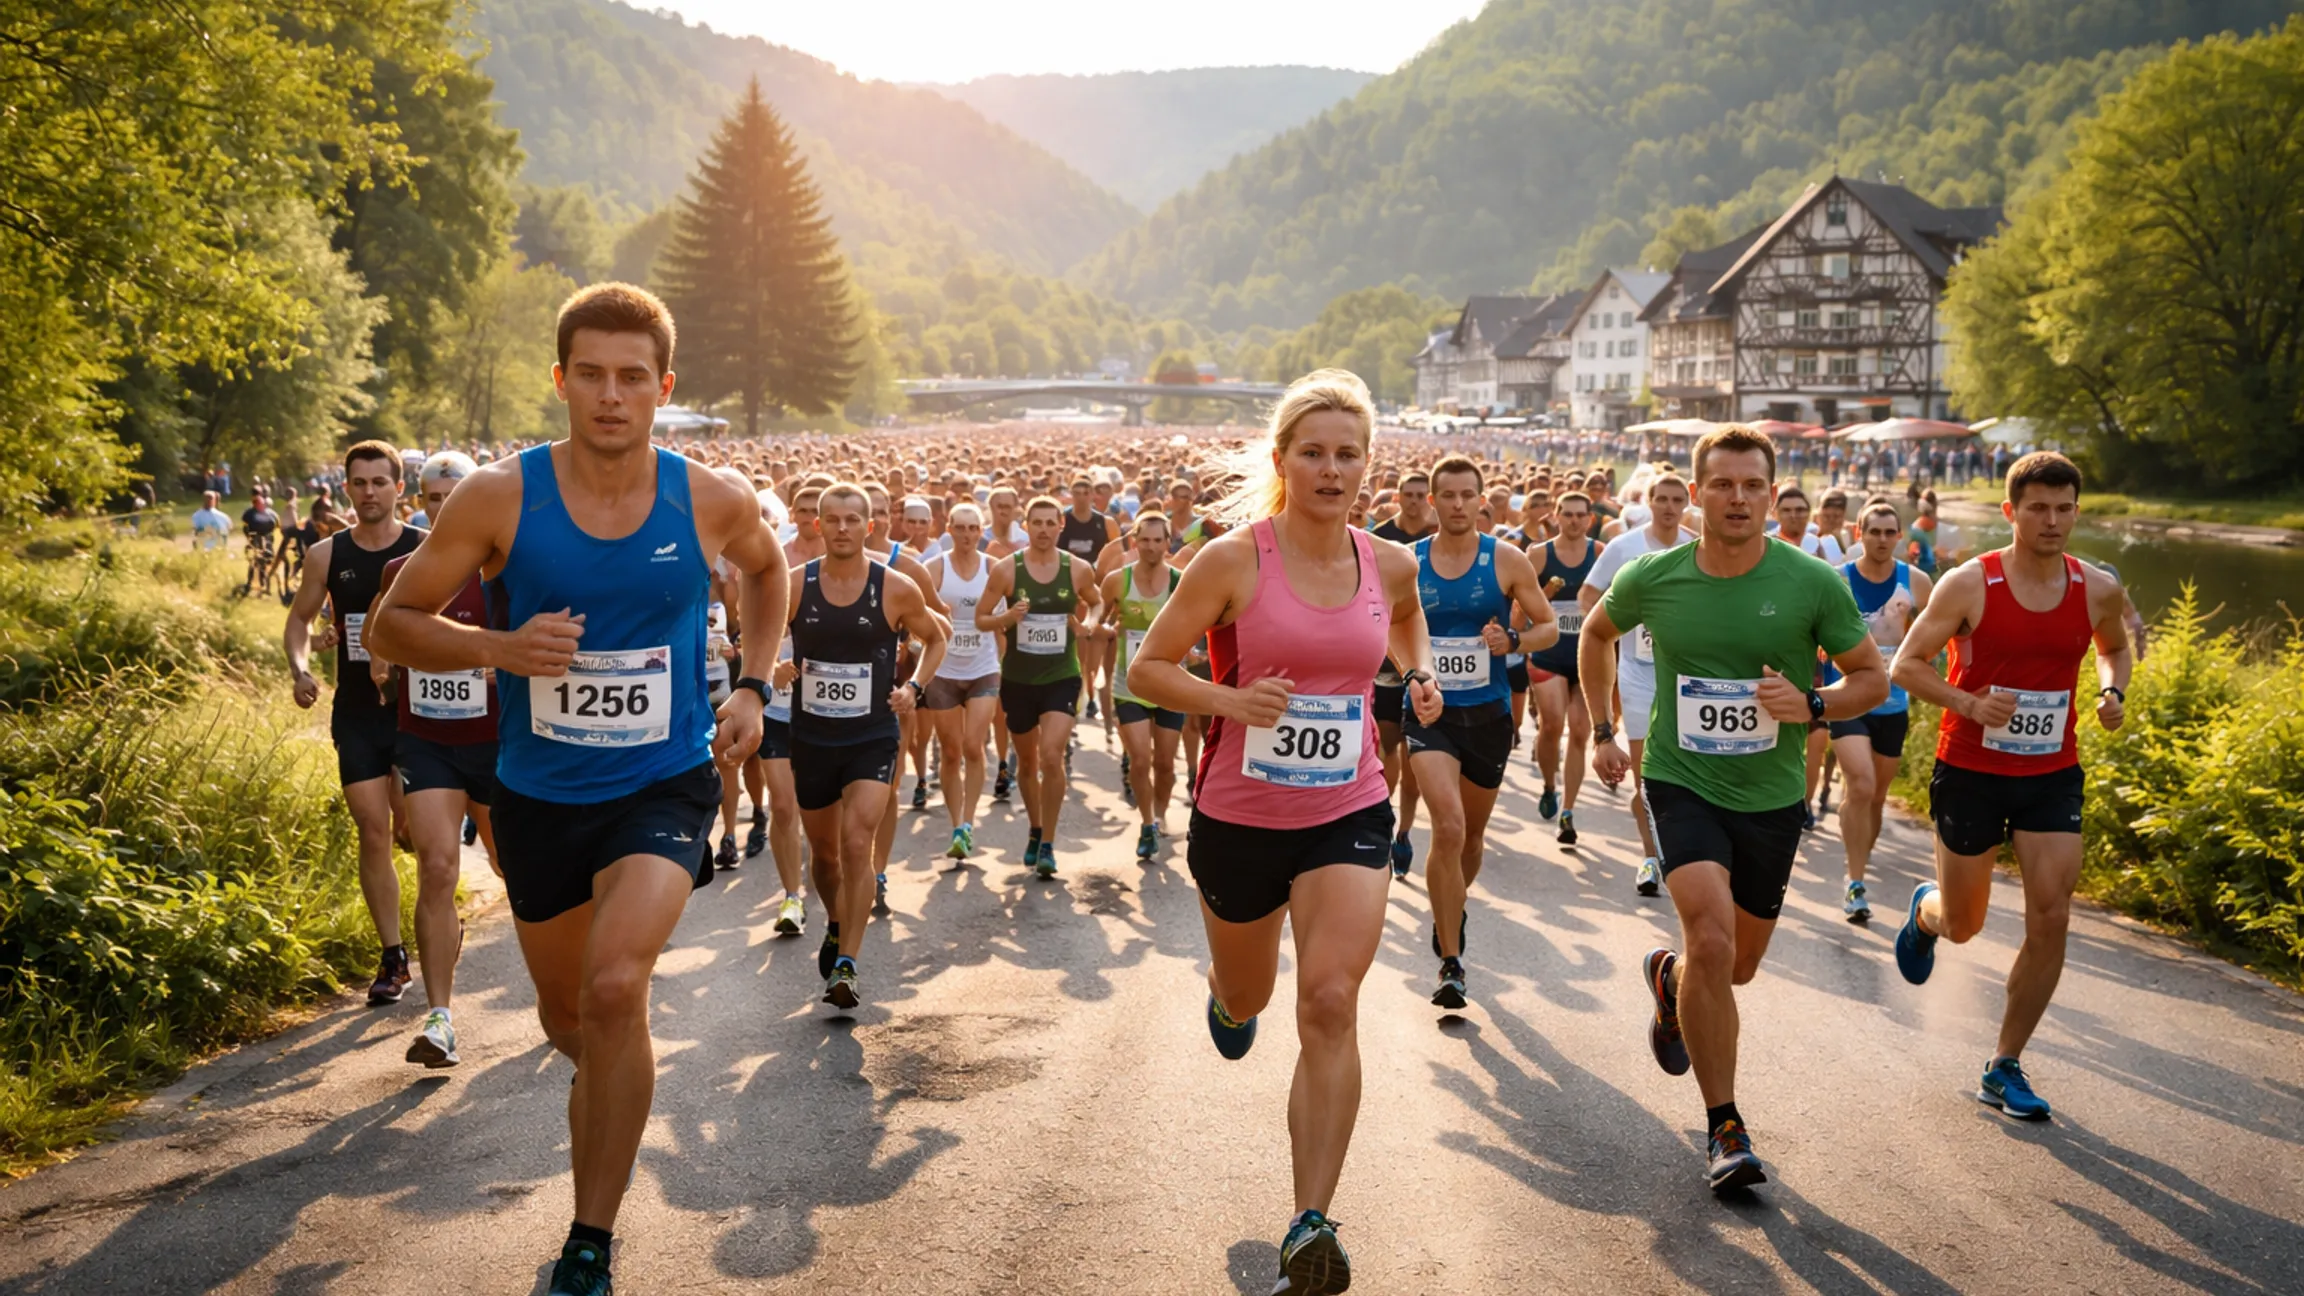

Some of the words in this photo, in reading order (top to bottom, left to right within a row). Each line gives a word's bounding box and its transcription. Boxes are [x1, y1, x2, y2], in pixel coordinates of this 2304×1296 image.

[419, 678, 470, 701] 1986
[554, 682, 649, 718] 1256
[1272, 725, 1342, 760] 308
